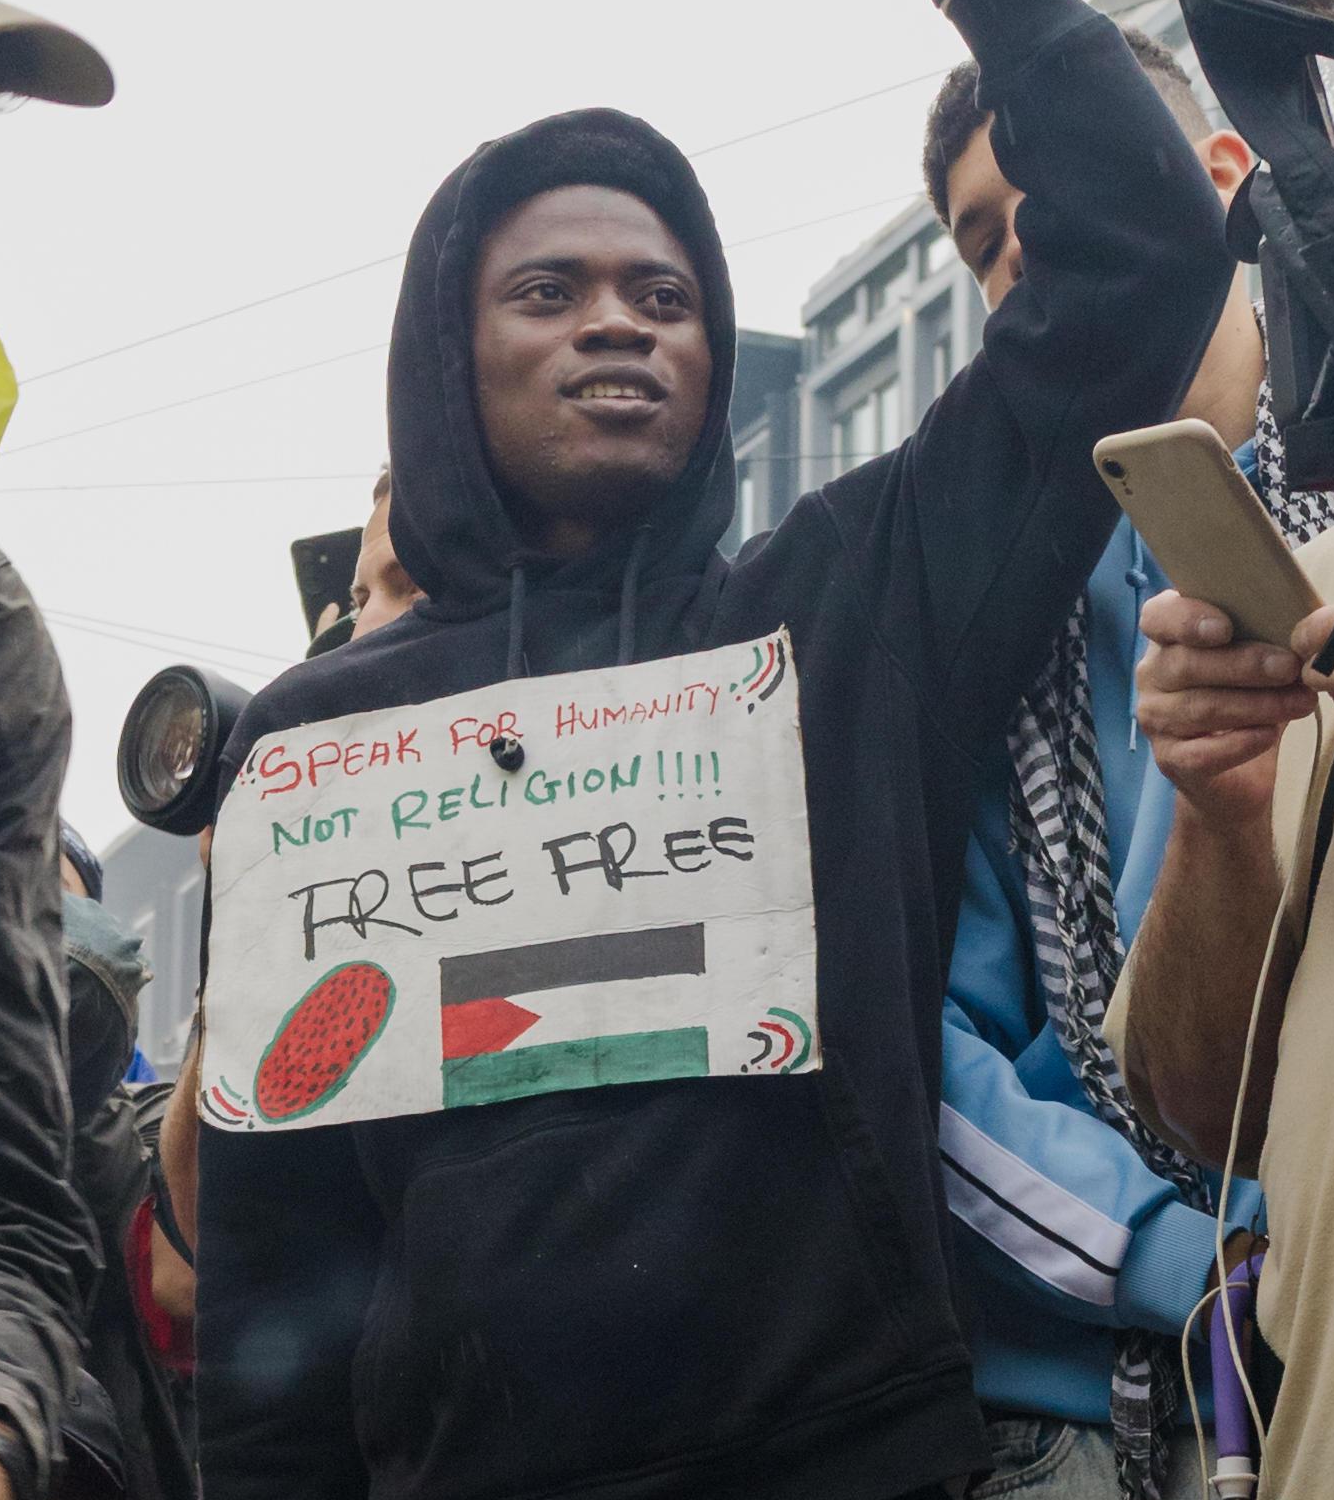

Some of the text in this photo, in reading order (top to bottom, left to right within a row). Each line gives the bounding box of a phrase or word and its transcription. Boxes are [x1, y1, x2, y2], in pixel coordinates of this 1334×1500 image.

[259, 728, 422, 800] SPEAK
[555, 682, 722, 740] HUMANITY
[271, 807, 360, 855] NOT
[287, 816, 756, 961] FREE FREE
